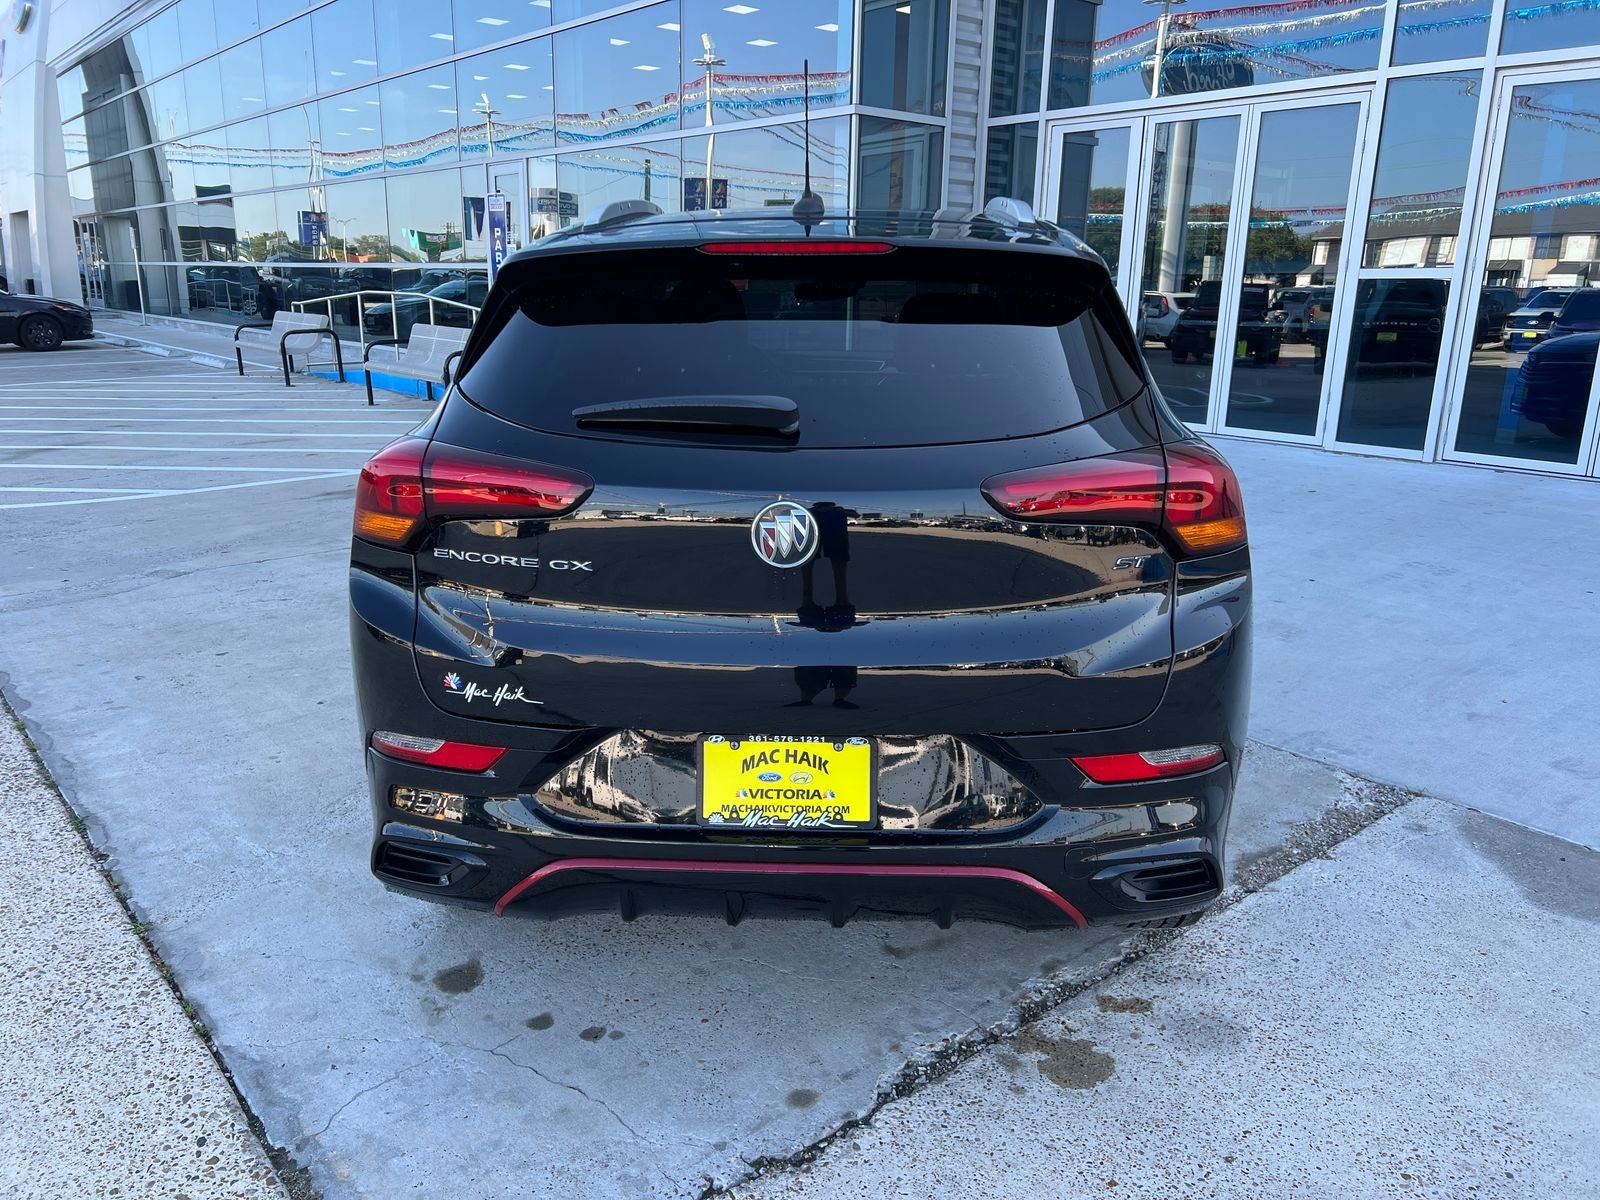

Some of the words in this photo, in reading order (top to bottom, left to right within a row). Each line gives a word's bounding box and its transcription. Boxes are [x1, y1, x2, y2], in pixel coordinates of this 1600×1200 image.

[433, 548, 539, 568] ENCORE
[549, 560, 593, 572] GX
[1112, 554, 1152, 570] ST
[455, 682, 493, 703] Mac
[492, 683, 544, 706] Haik
[748, 735, 826, 743] 361-576-1221
[741, 749, 780, 774] MAC
[785, 749, 829, 775] HAIK
[748, 788, 823, 800] VICTORIA
[739, 810, 785, 828] Mac
[786, 811, 857, 828] Haik
